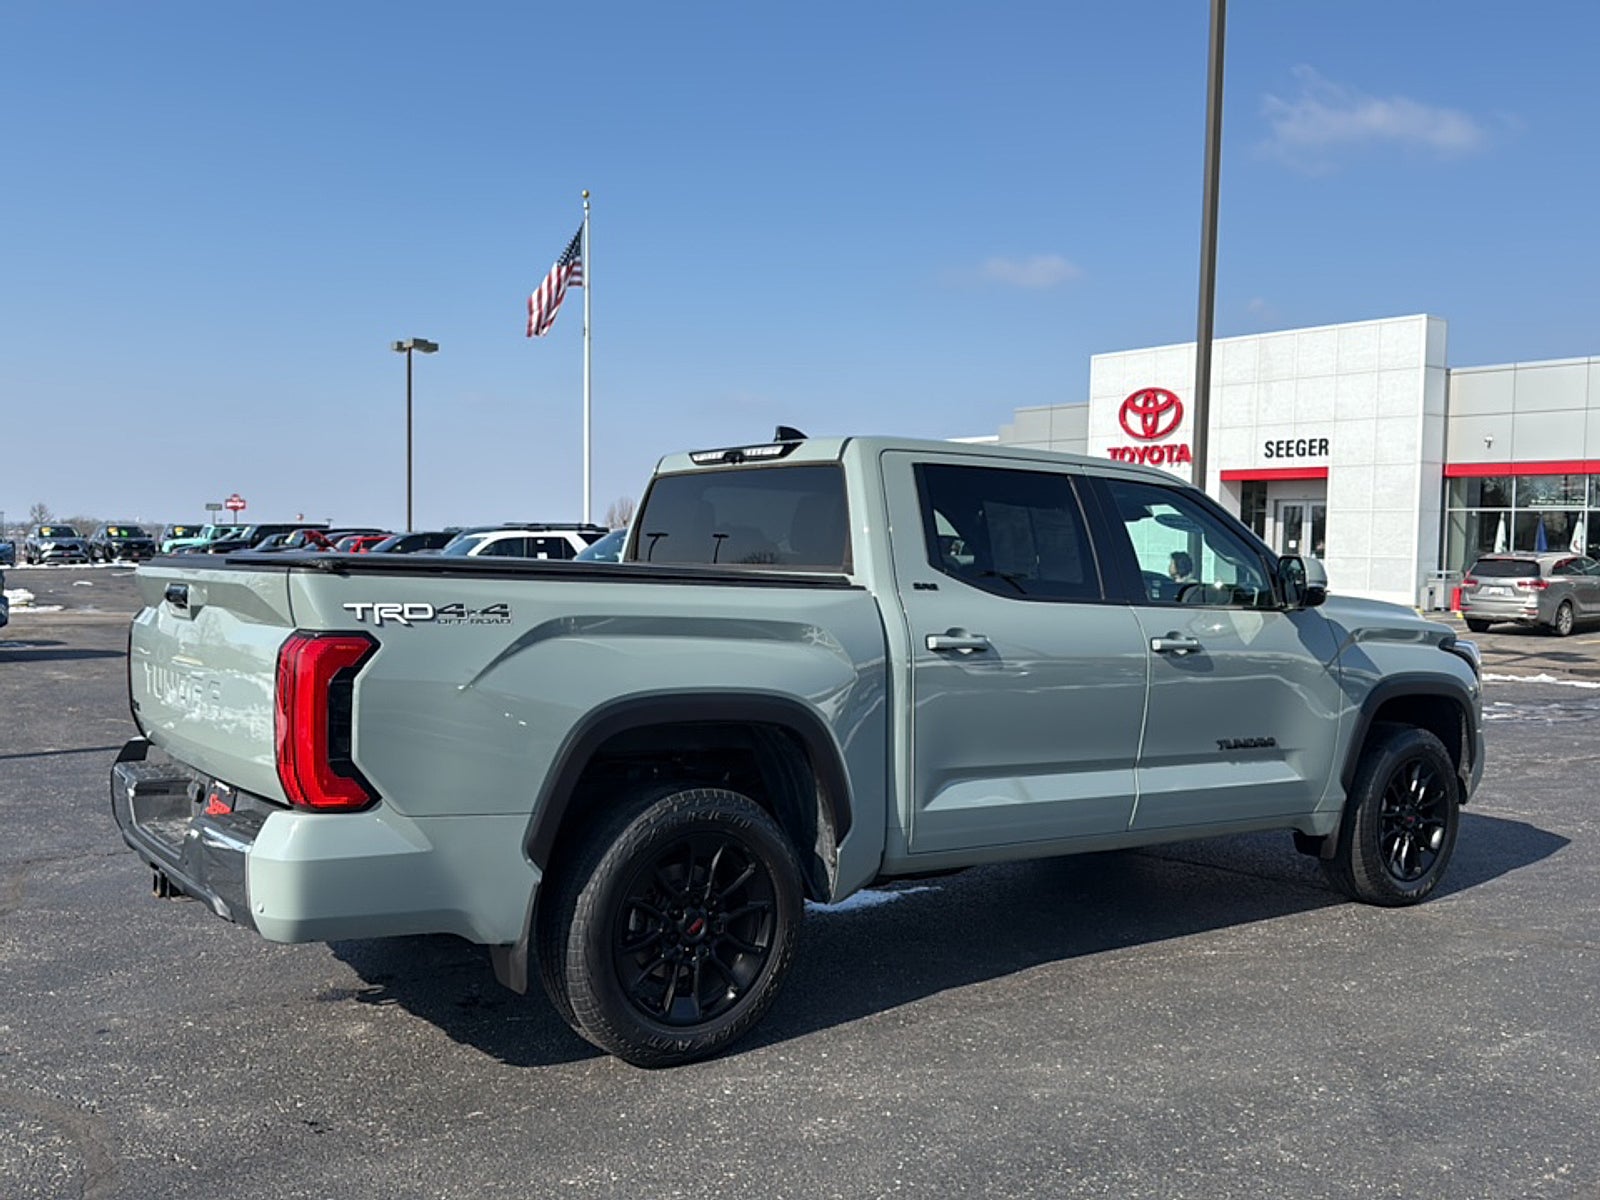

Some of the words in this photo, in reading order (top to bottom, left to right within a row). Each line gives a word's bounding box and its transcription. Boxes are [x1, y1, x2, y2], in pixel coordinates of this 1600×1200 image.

[1107, 443, 1191, 464] TOYOTA
[1264, 438, 1329, 458] SEEGER
[343, 602, 435, 626] TRD
